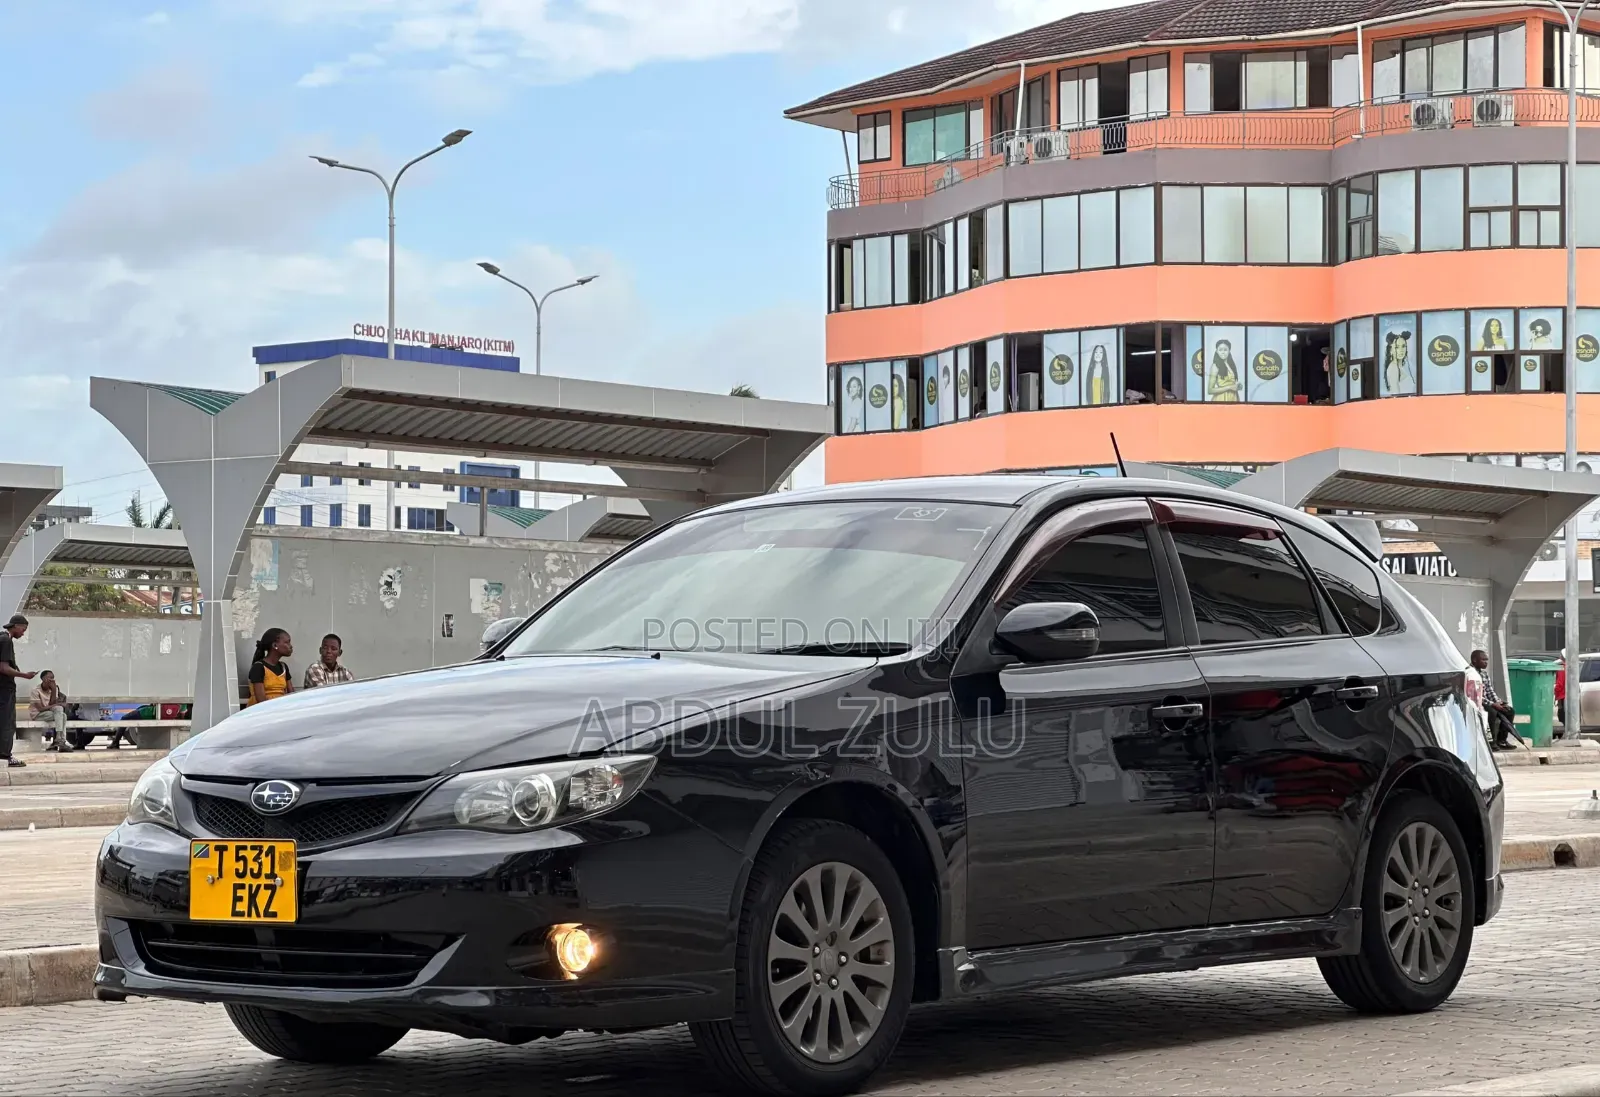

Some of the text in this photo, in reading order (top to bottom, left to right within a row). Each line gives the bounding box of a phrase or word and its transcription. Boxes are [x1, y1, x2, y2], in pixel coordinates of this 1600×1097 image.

[353, 322, 386, 338] CHUO
[483, 337, 515, 353] (KITM)
[1255, 364, 1280, 372] asnath
[1431, 351, 1457, 359] asnath
[214, 844, 278, 880] T 531
[231, 883, 278, 918] EKZ
